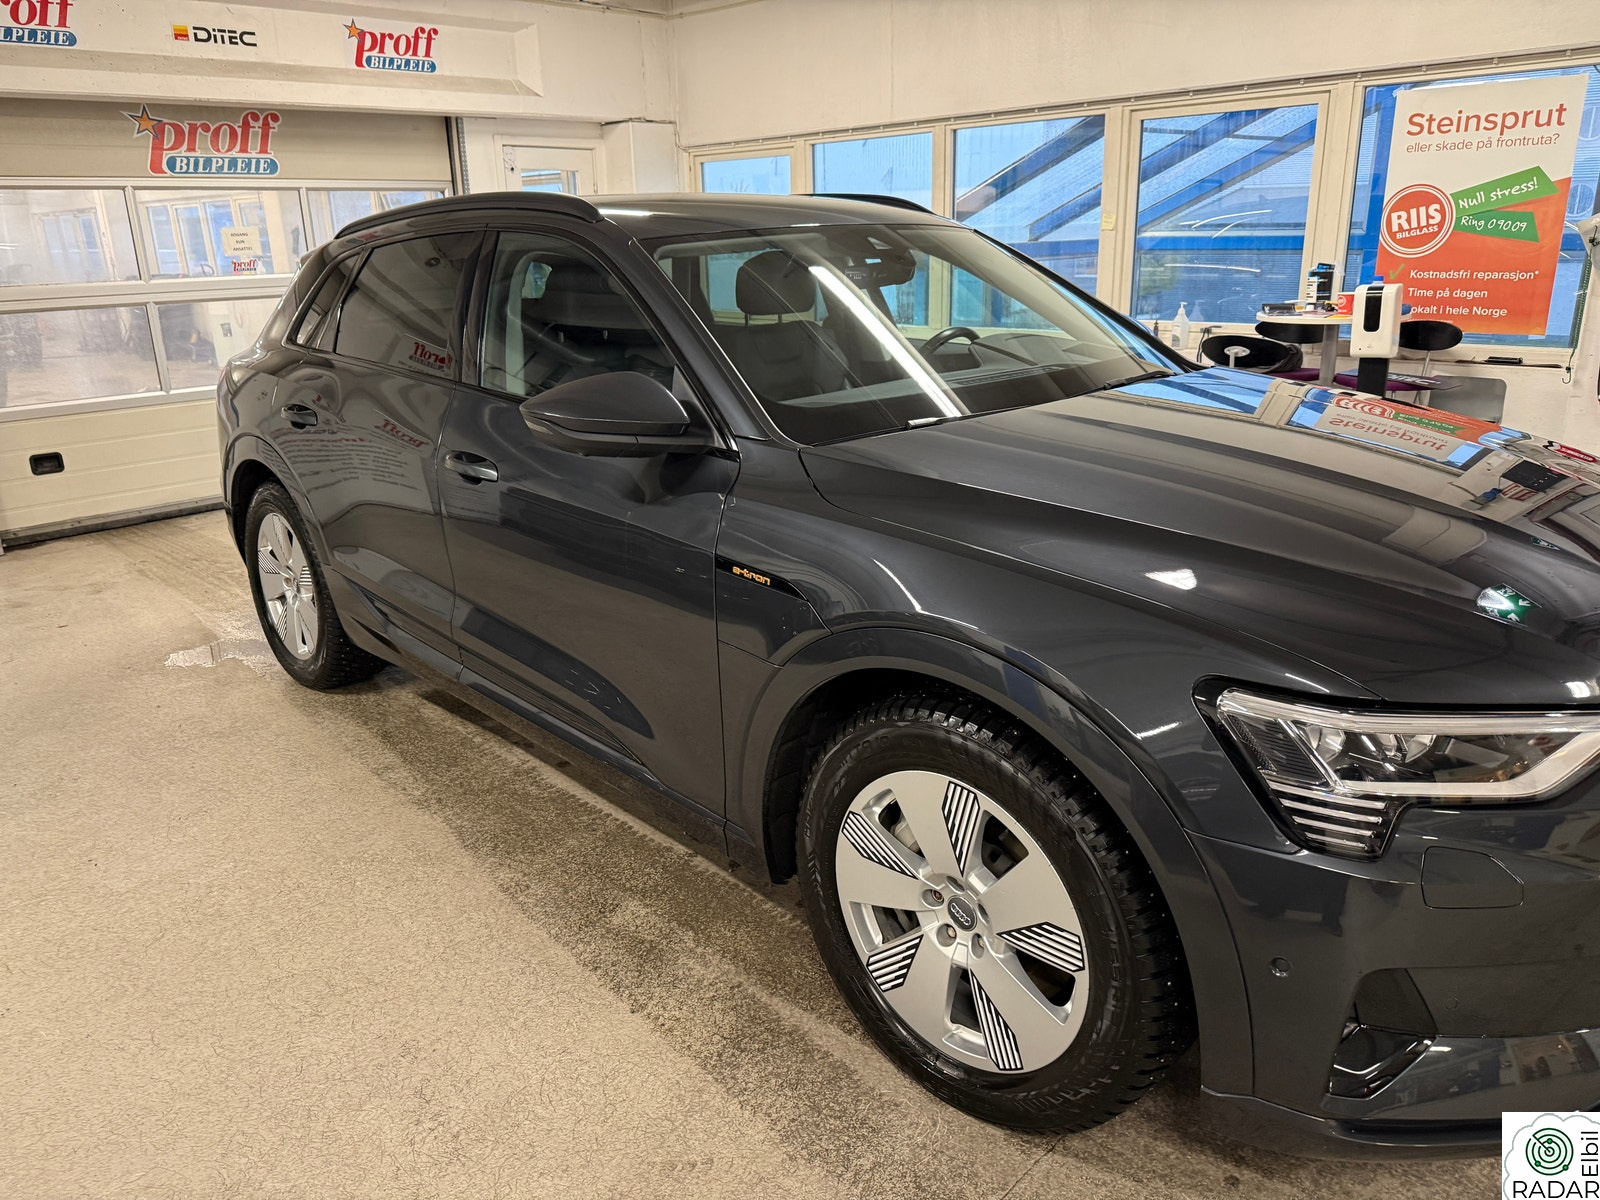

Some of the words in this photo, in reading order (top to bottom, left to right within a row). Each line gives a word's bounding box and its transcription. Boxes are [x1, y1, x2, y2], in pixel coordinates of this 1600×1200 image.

[355, 26, 439, 69] proff
[370, 56, 432, 73] BILPLEIE
[1406, 103, 1568, 136] Steinsprut
[150, 111, 280, 174] proff
[1406, 142, 1433, 153] eller
[1435, 139, 1473, 152] skade
[1476, 136, 1492, 151] på
[1496, 133, 1560, 148] frontruta?
[174, 157, 271, 174] BILPLEIE
[1458, 192, 1486, 209] Null
[1489, 177, 1539, 202] stress!
[1390, 203, 1442, 233] RIIS
[1460, 215, 1485, 231] Ring
[1487, 219, 1528, 232] 09009
[1396, 225, 1439, 240] BILGLASS
[1409, 269, 1471, 279] Kostnadsfri
[1408, 287, 1434, 297] Time
[1436, 287, 1450, 299] på
[1453, 288, 1488, 300] dagen
[1408, 305, 1437, 314] okalt
[1445, 306, 1470, 315] hele
[1472, 306, 1508, 317] Norge
[732, 566, 771, 586] e-tron
